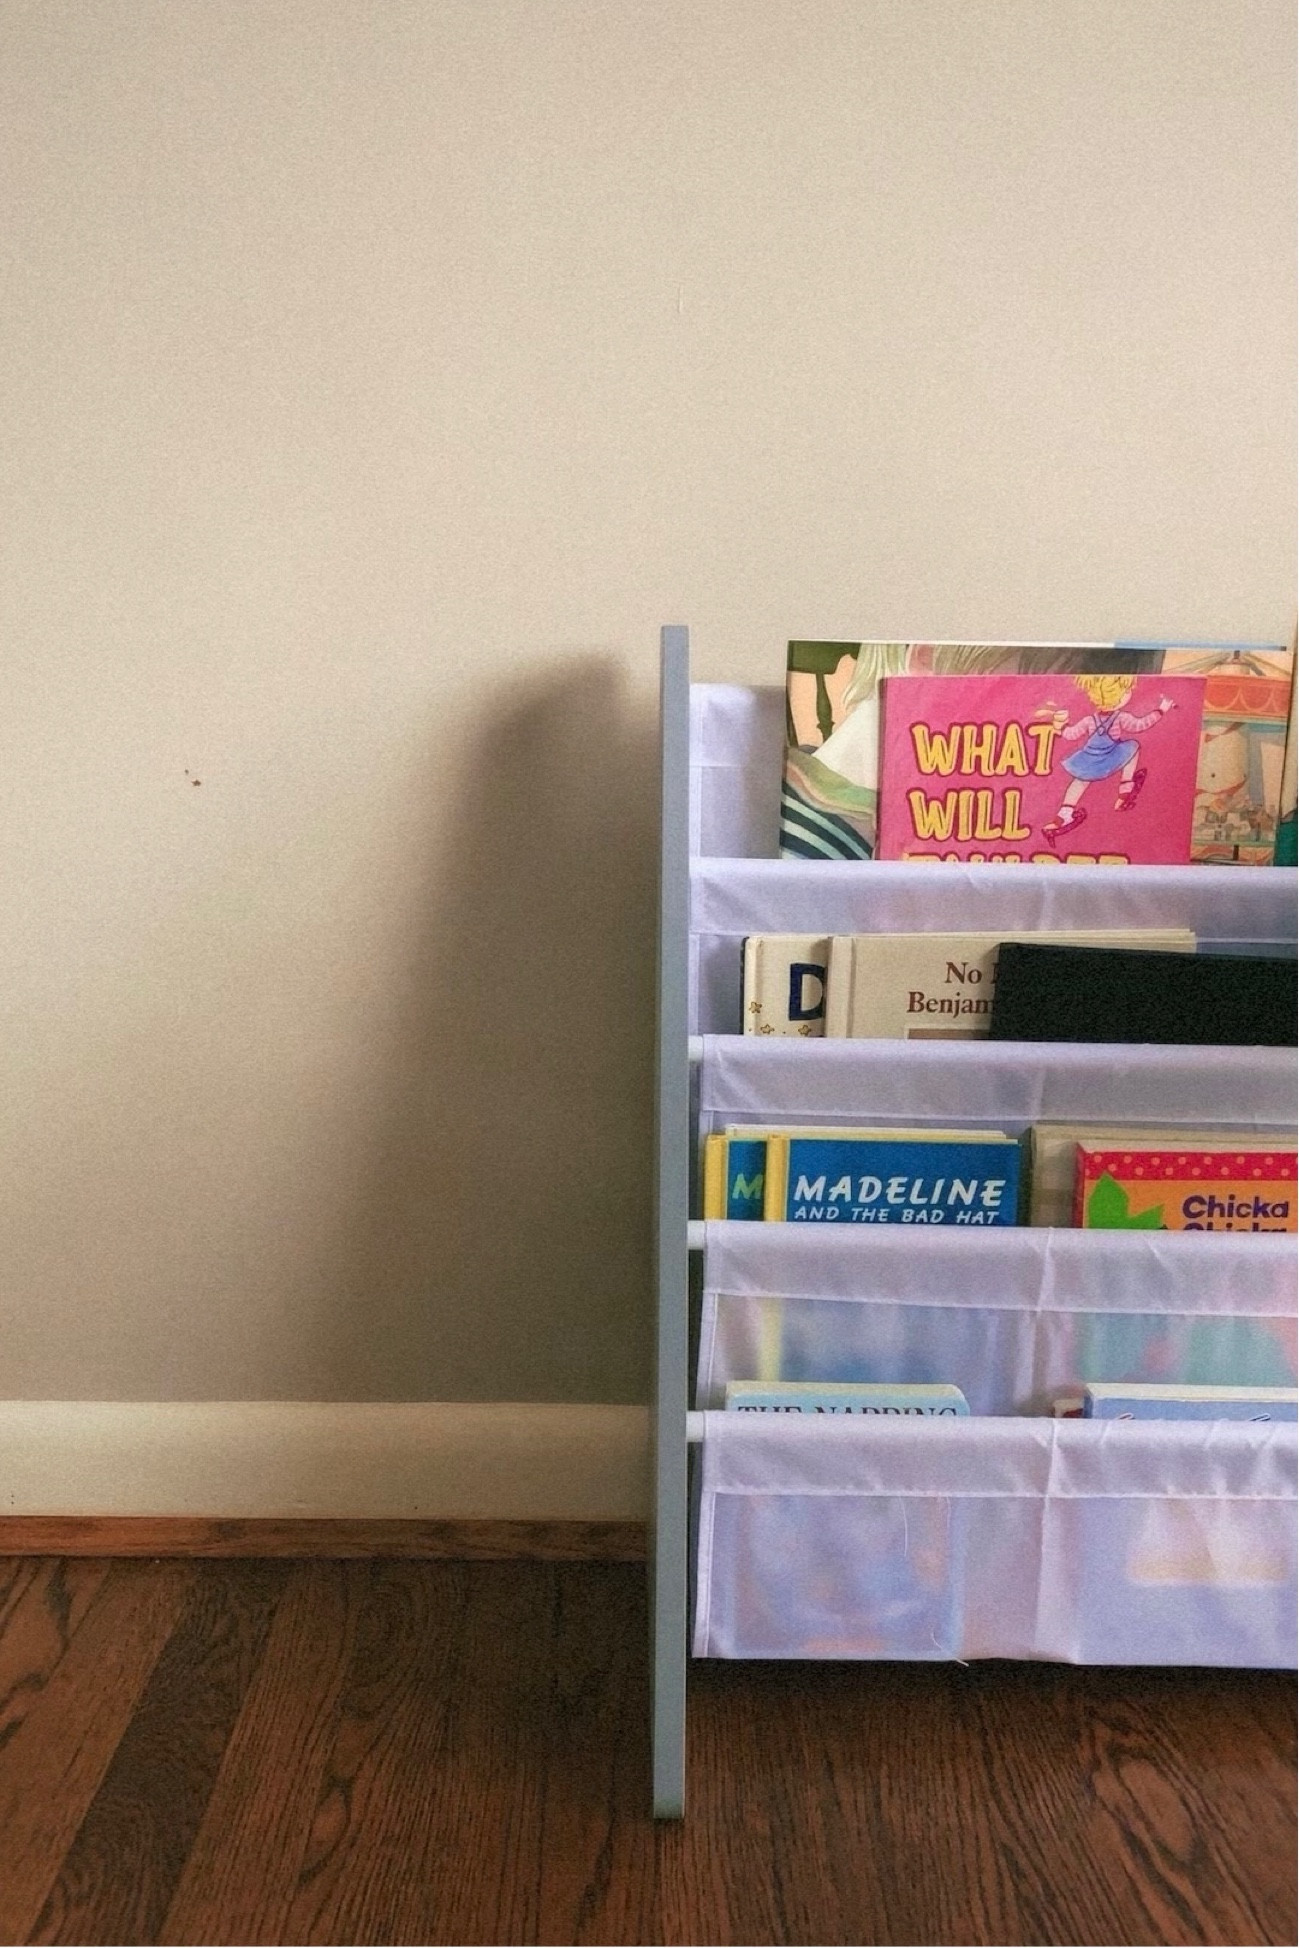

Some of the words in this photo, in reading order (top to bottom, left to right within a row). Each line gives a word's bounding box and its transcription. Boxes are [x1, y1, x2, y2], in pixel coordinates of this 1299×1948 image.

[910, 721, 1064, 777] WHAT
[907, 787, 1032, 842] WILL
[944, 961, 982, 985] No
[732, 1173, 764, 1200] M
[793, 1174, 1007, 1207] MADELINE
[794, 1206, 839, 1219] AND
[851, 1207, 890, 1222] THE
[902, 1209, 945, 1223] BAD
[956, 1210, 1000, 1224] HAT
[1182, 1193, 1289, 1219] Chicka
